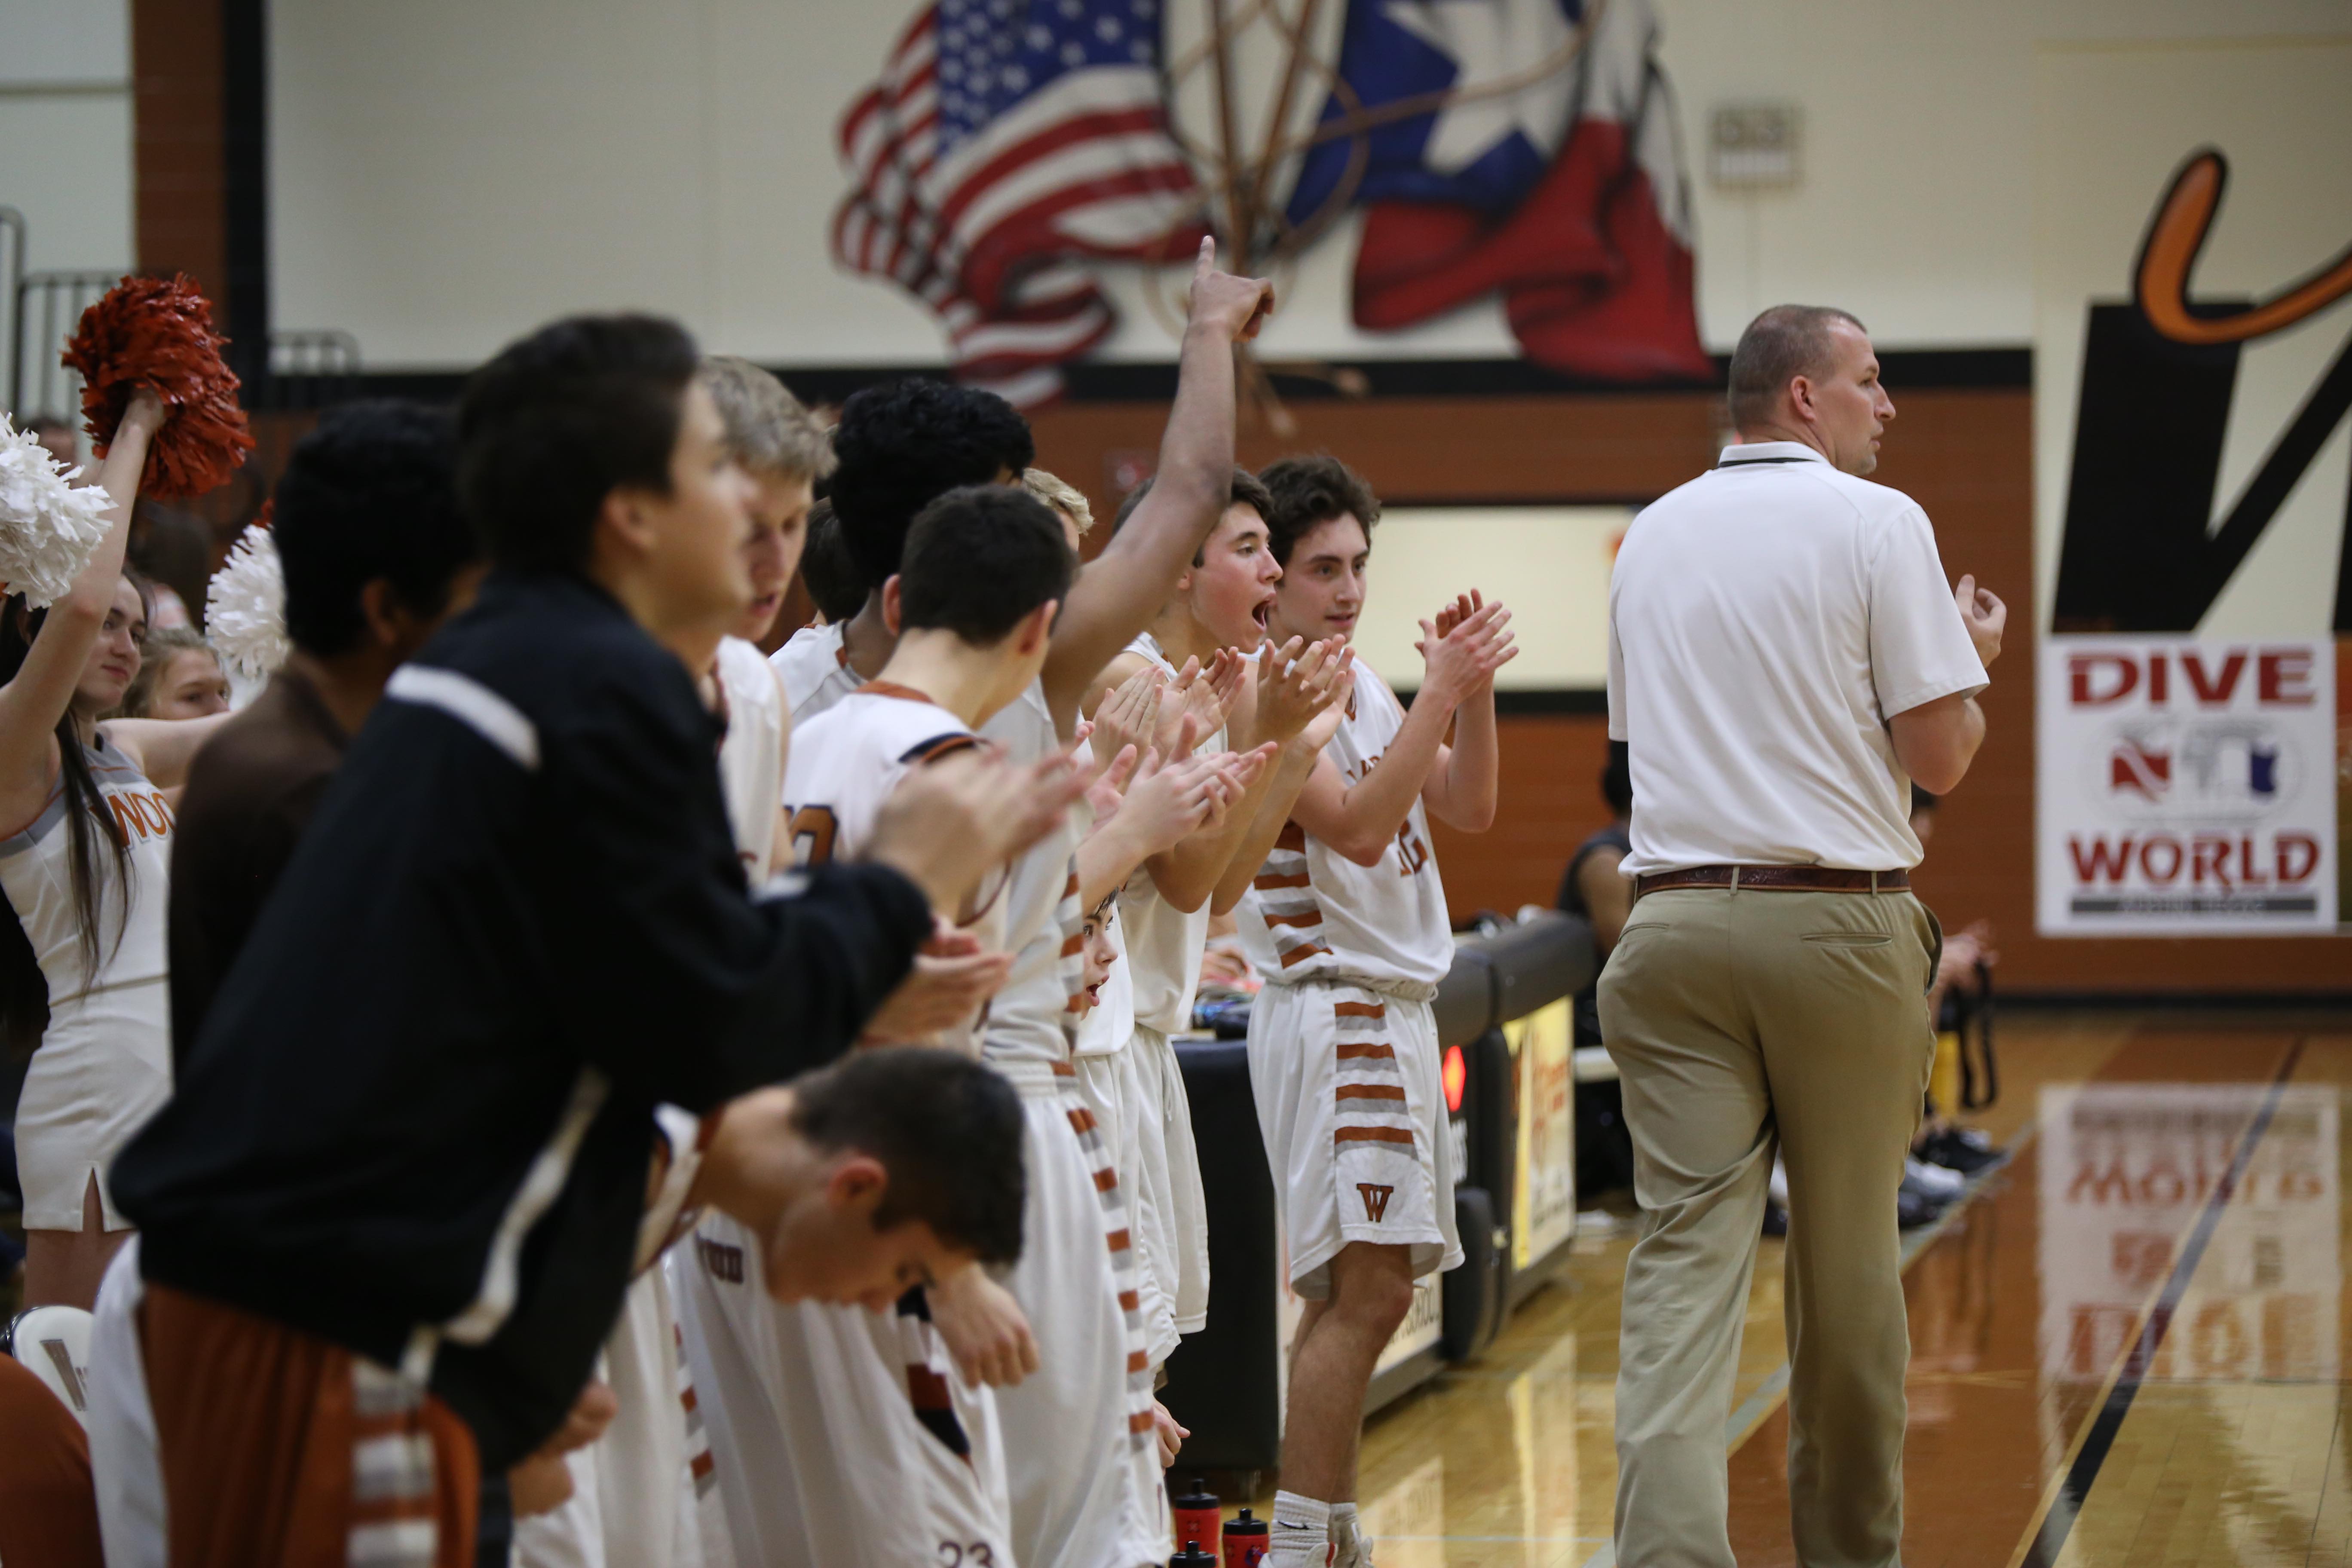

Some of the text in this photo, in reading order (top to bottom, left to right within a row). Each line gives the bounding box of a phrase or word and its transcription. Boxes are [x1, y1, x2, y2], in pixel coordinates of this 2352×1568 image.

[2068, 650, 2316, 710] DIVE
[2068, 832, 2320, 893] WORLD
[1356, 1183, 1394, 1223] W
